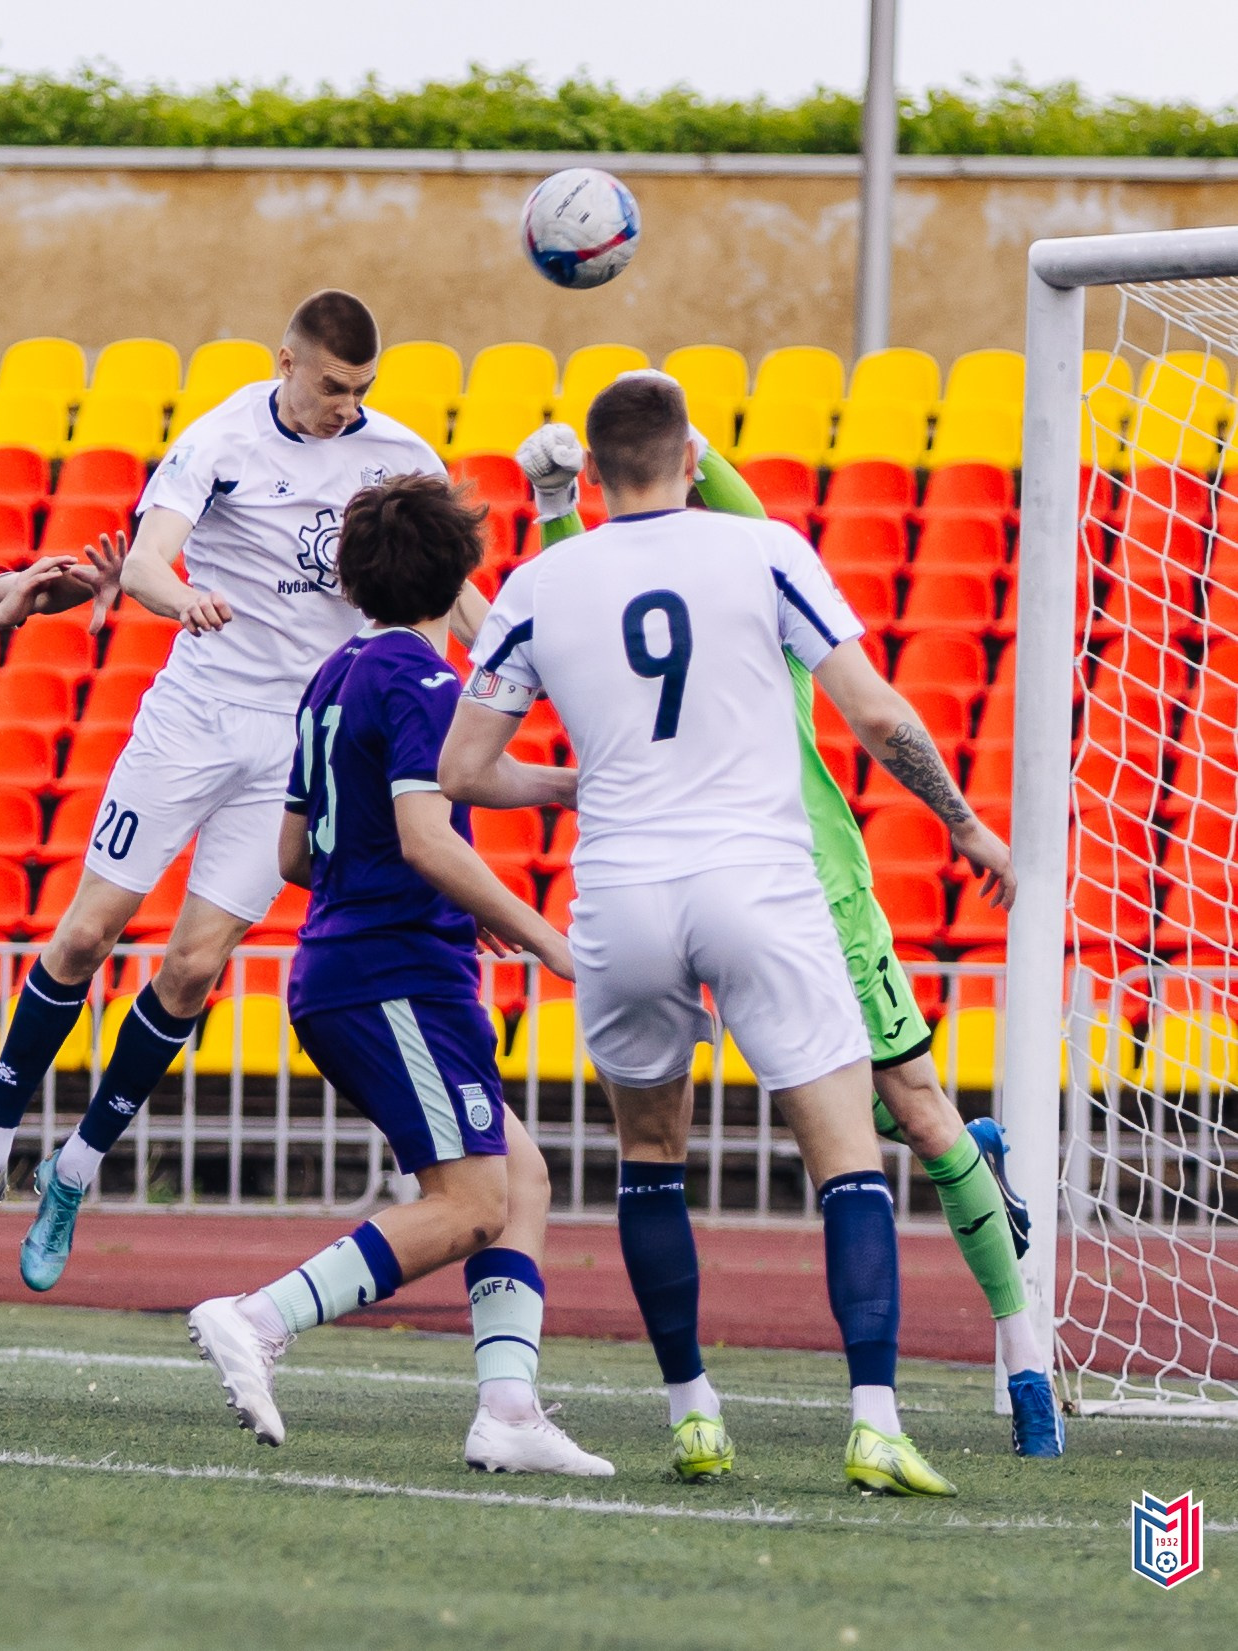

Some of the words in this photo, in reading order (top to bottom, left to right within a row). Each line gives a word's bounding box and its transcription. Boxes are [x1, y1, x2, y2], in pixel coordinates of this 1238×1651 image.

[621, 588, 693, 743] 9
[507, 684, 516, 694] 9
[92, 799, 139, 860] 20
[876, 955, 898, 1008] 1
[624, 1183, 680, 1194] KELME
[470, 1291, 481, 1305] C
[481, 1279, 517, 1297] UFA
